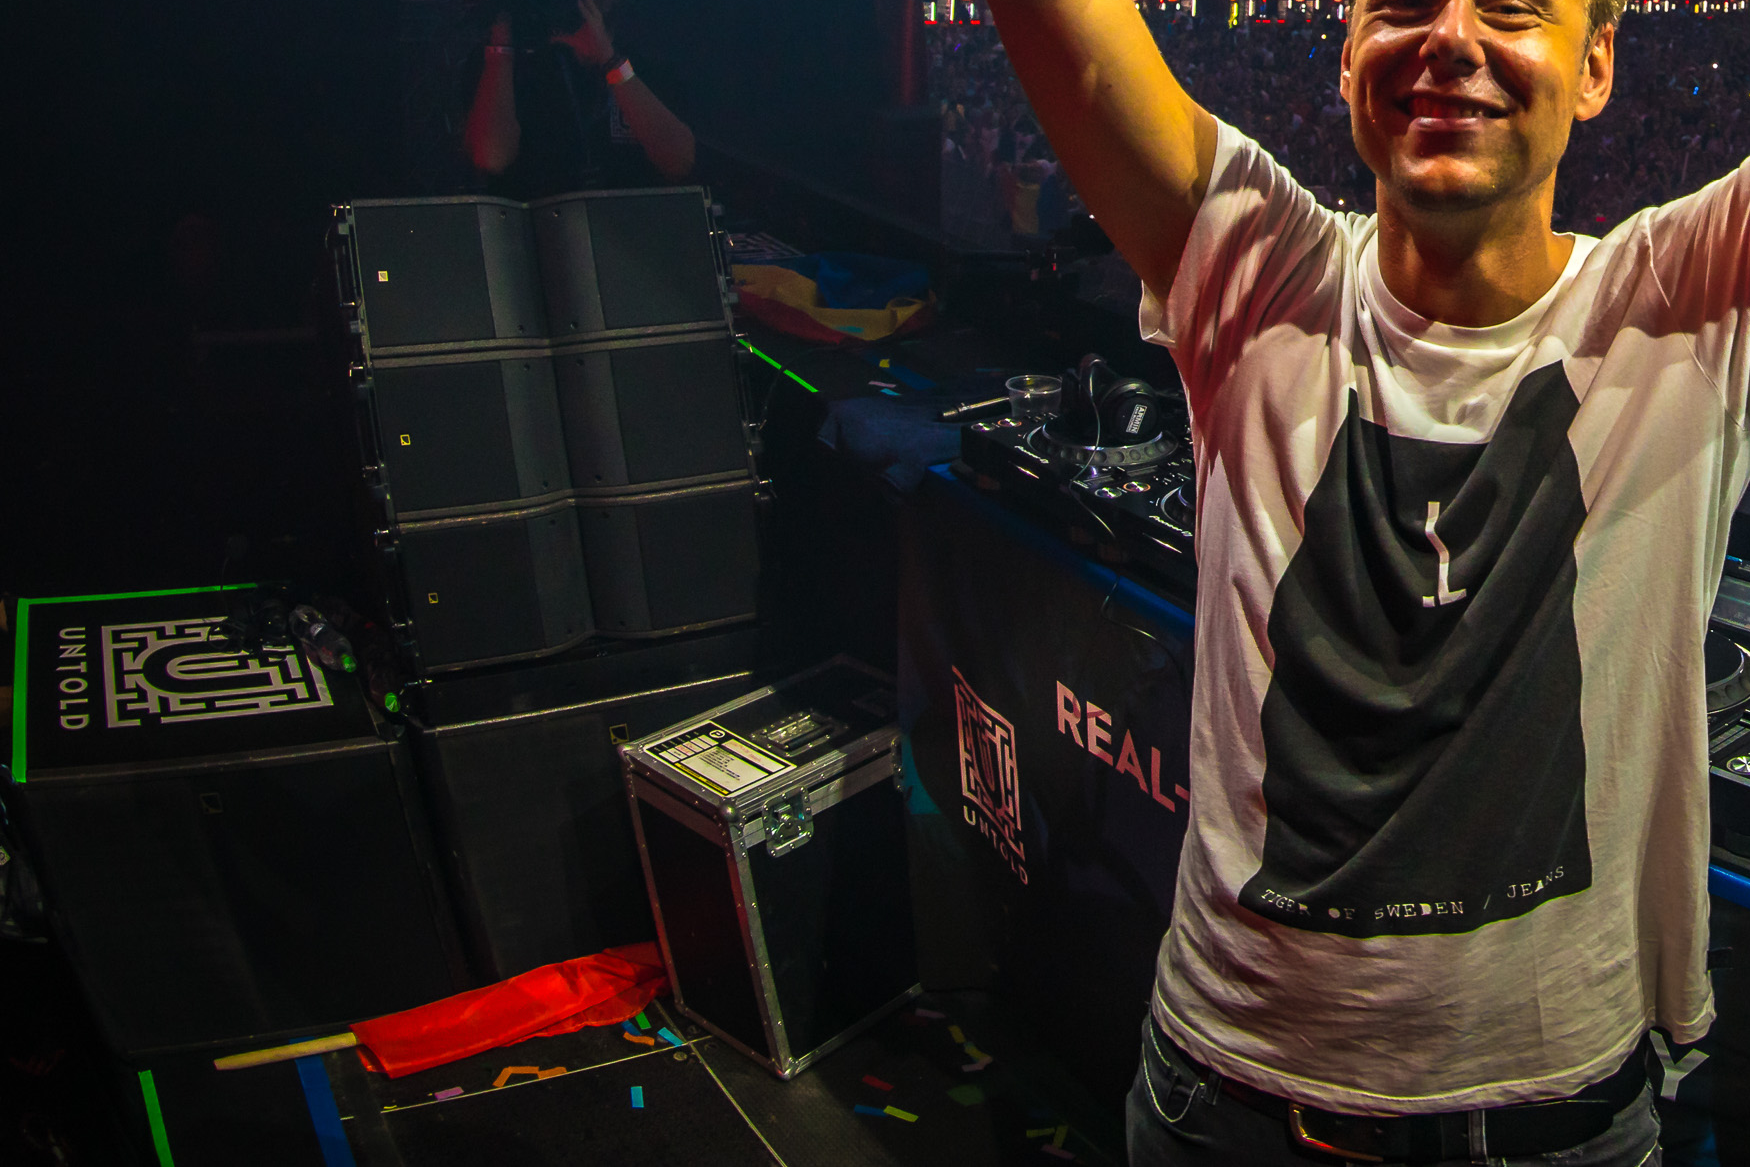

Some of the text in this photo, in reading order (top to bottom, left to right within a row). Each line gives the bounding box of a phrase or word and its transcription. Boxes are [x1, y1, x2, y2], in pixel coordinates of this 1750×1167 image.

[55, 626, 91, 731] UNTOLD
[962, 804, 1029, 886] UNTOLD
[1260, 888, 1313, 917] TIGER
[1327, 906, 1357, 920] OF
[1482, 893, 1493, 911] /
[1506, 865, 1565, 899] JEANS
